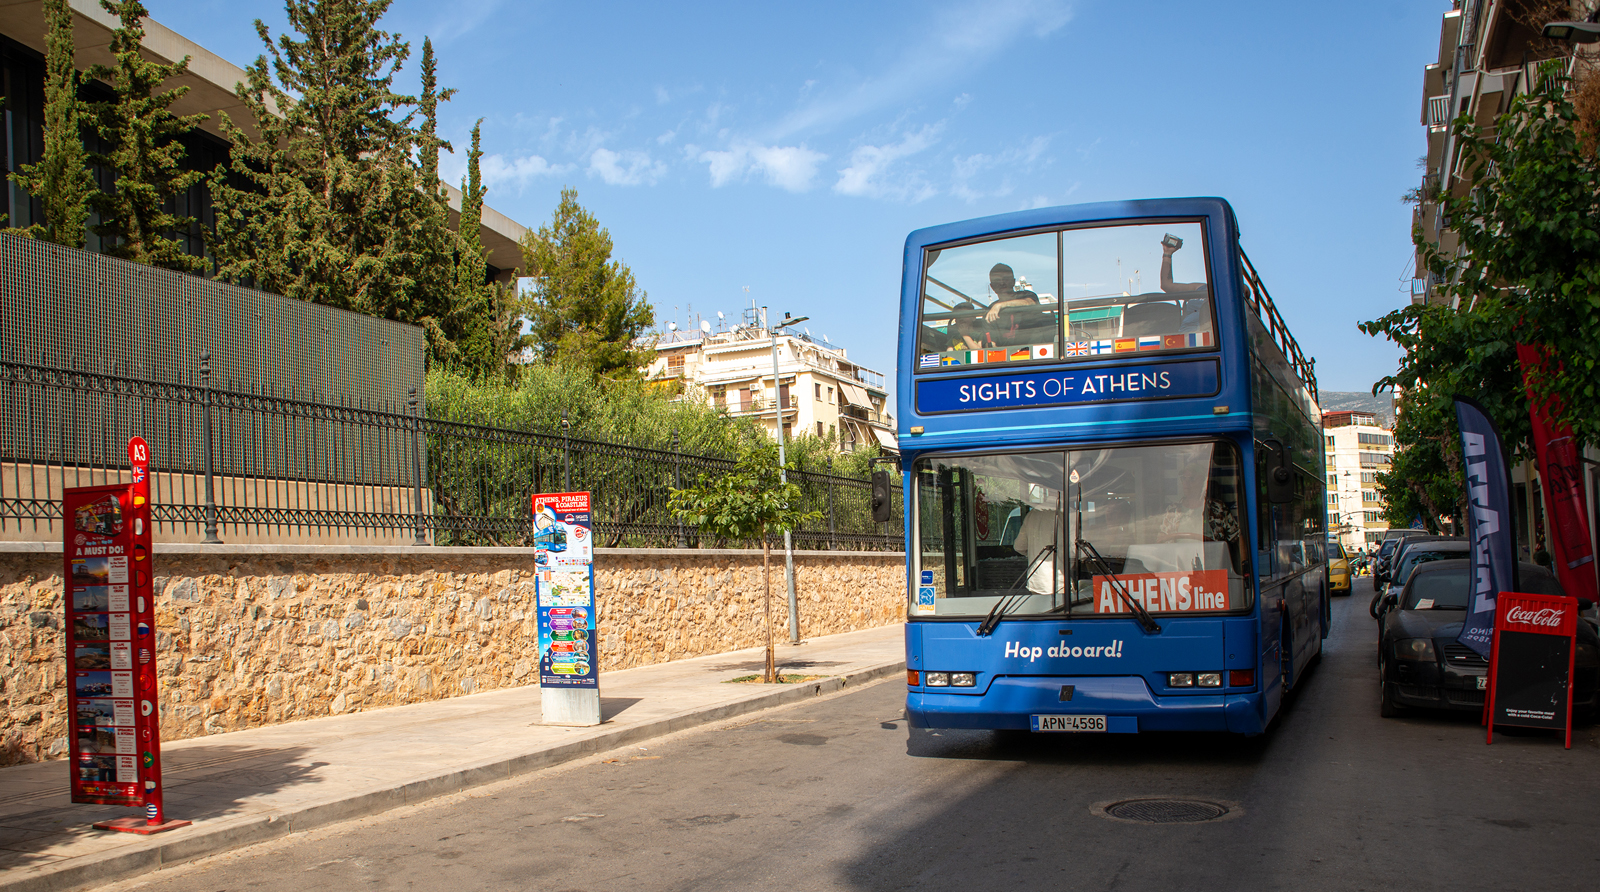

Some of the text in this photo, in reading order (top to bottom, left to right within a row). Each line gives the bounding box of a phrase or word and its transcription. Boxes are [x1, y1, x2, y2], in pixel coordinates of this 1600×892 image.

[959, 371, 1171, 402] SIGHTS OF ATHENS
[134, 444, 146, 462] A3
[535, 496, 560, 504] ATHENS,
[76, 545, 124, 556] A MUST DO!
[1099, 576, 1225, 613] ATHENS line
[1506, 605, 1566, 626] Coca-Cola
[1004, 640, 1123, 662] Hop aboard!
